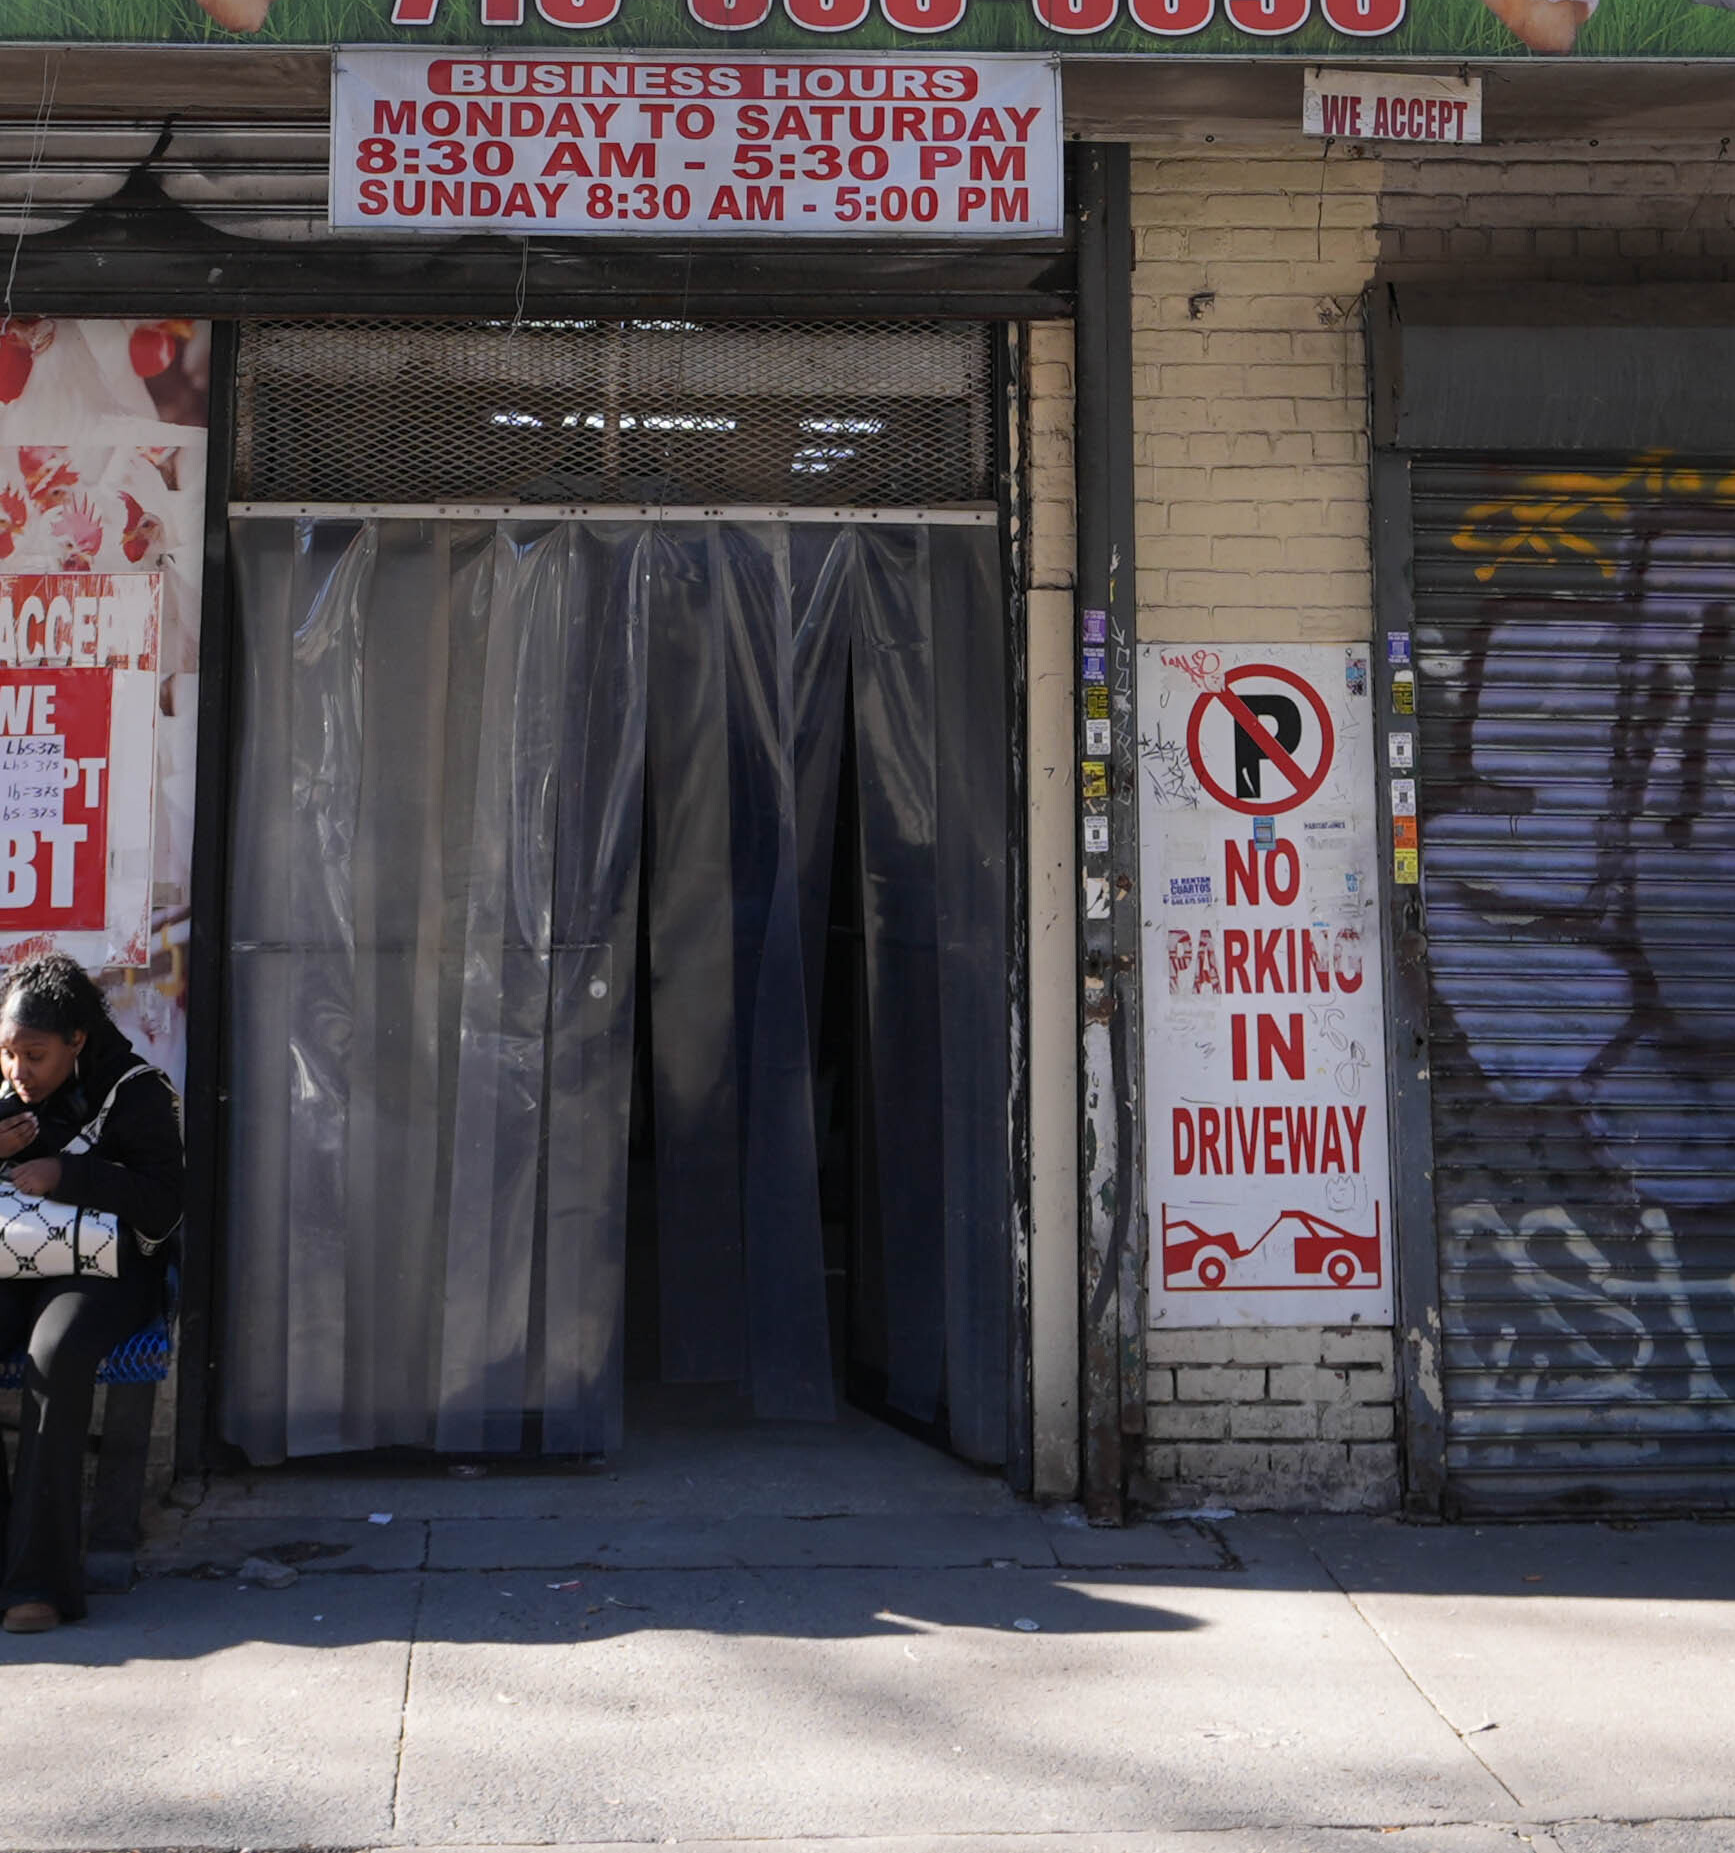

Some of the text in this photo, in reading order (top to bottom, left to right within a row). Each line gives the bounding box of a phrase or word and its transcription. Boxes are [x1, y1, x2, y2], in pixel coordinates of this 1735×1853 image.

[449, 66, 967, 100] BUSINESS HOURS
[371, 100, 1042, 144] MONDAY TO SATURDAY
[1320, 94, 1468, 141] WE ACCEPT
[355, 137, 1027, 183] 8:30 AM - 5:30 PM
[357, 180, 1030, 224] SUNDAY 8:30 AM - 5:00 PM
[1224, 837, 1301, 907] NO
[1230, 1013, 1306, 1082] IN
[1172, 1105, 1368, 1176] DRIVEWAY
[46, 1226, 67, 1241] SM
